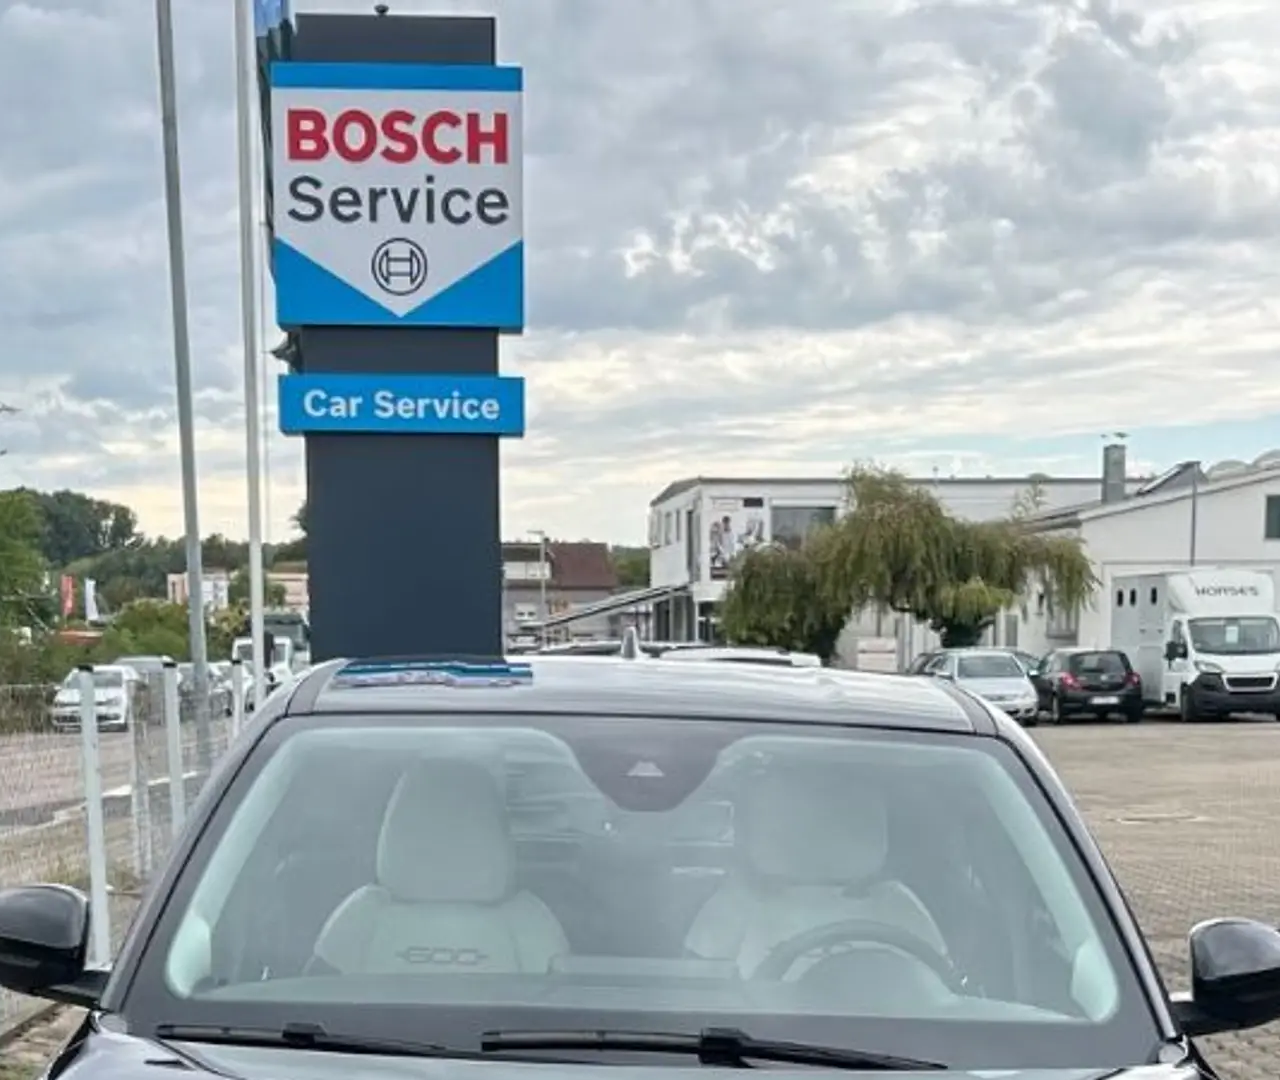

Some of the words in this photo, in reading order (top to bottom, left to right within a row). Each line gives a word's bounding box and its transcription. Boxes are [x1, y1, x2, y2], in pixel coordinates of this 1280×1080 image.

[287, 108, 508, 164] BOSCH
[287, 175, 509, 225] Service
[304, 389, 362, 418] Car
[374, 390, 500, 420] Service
